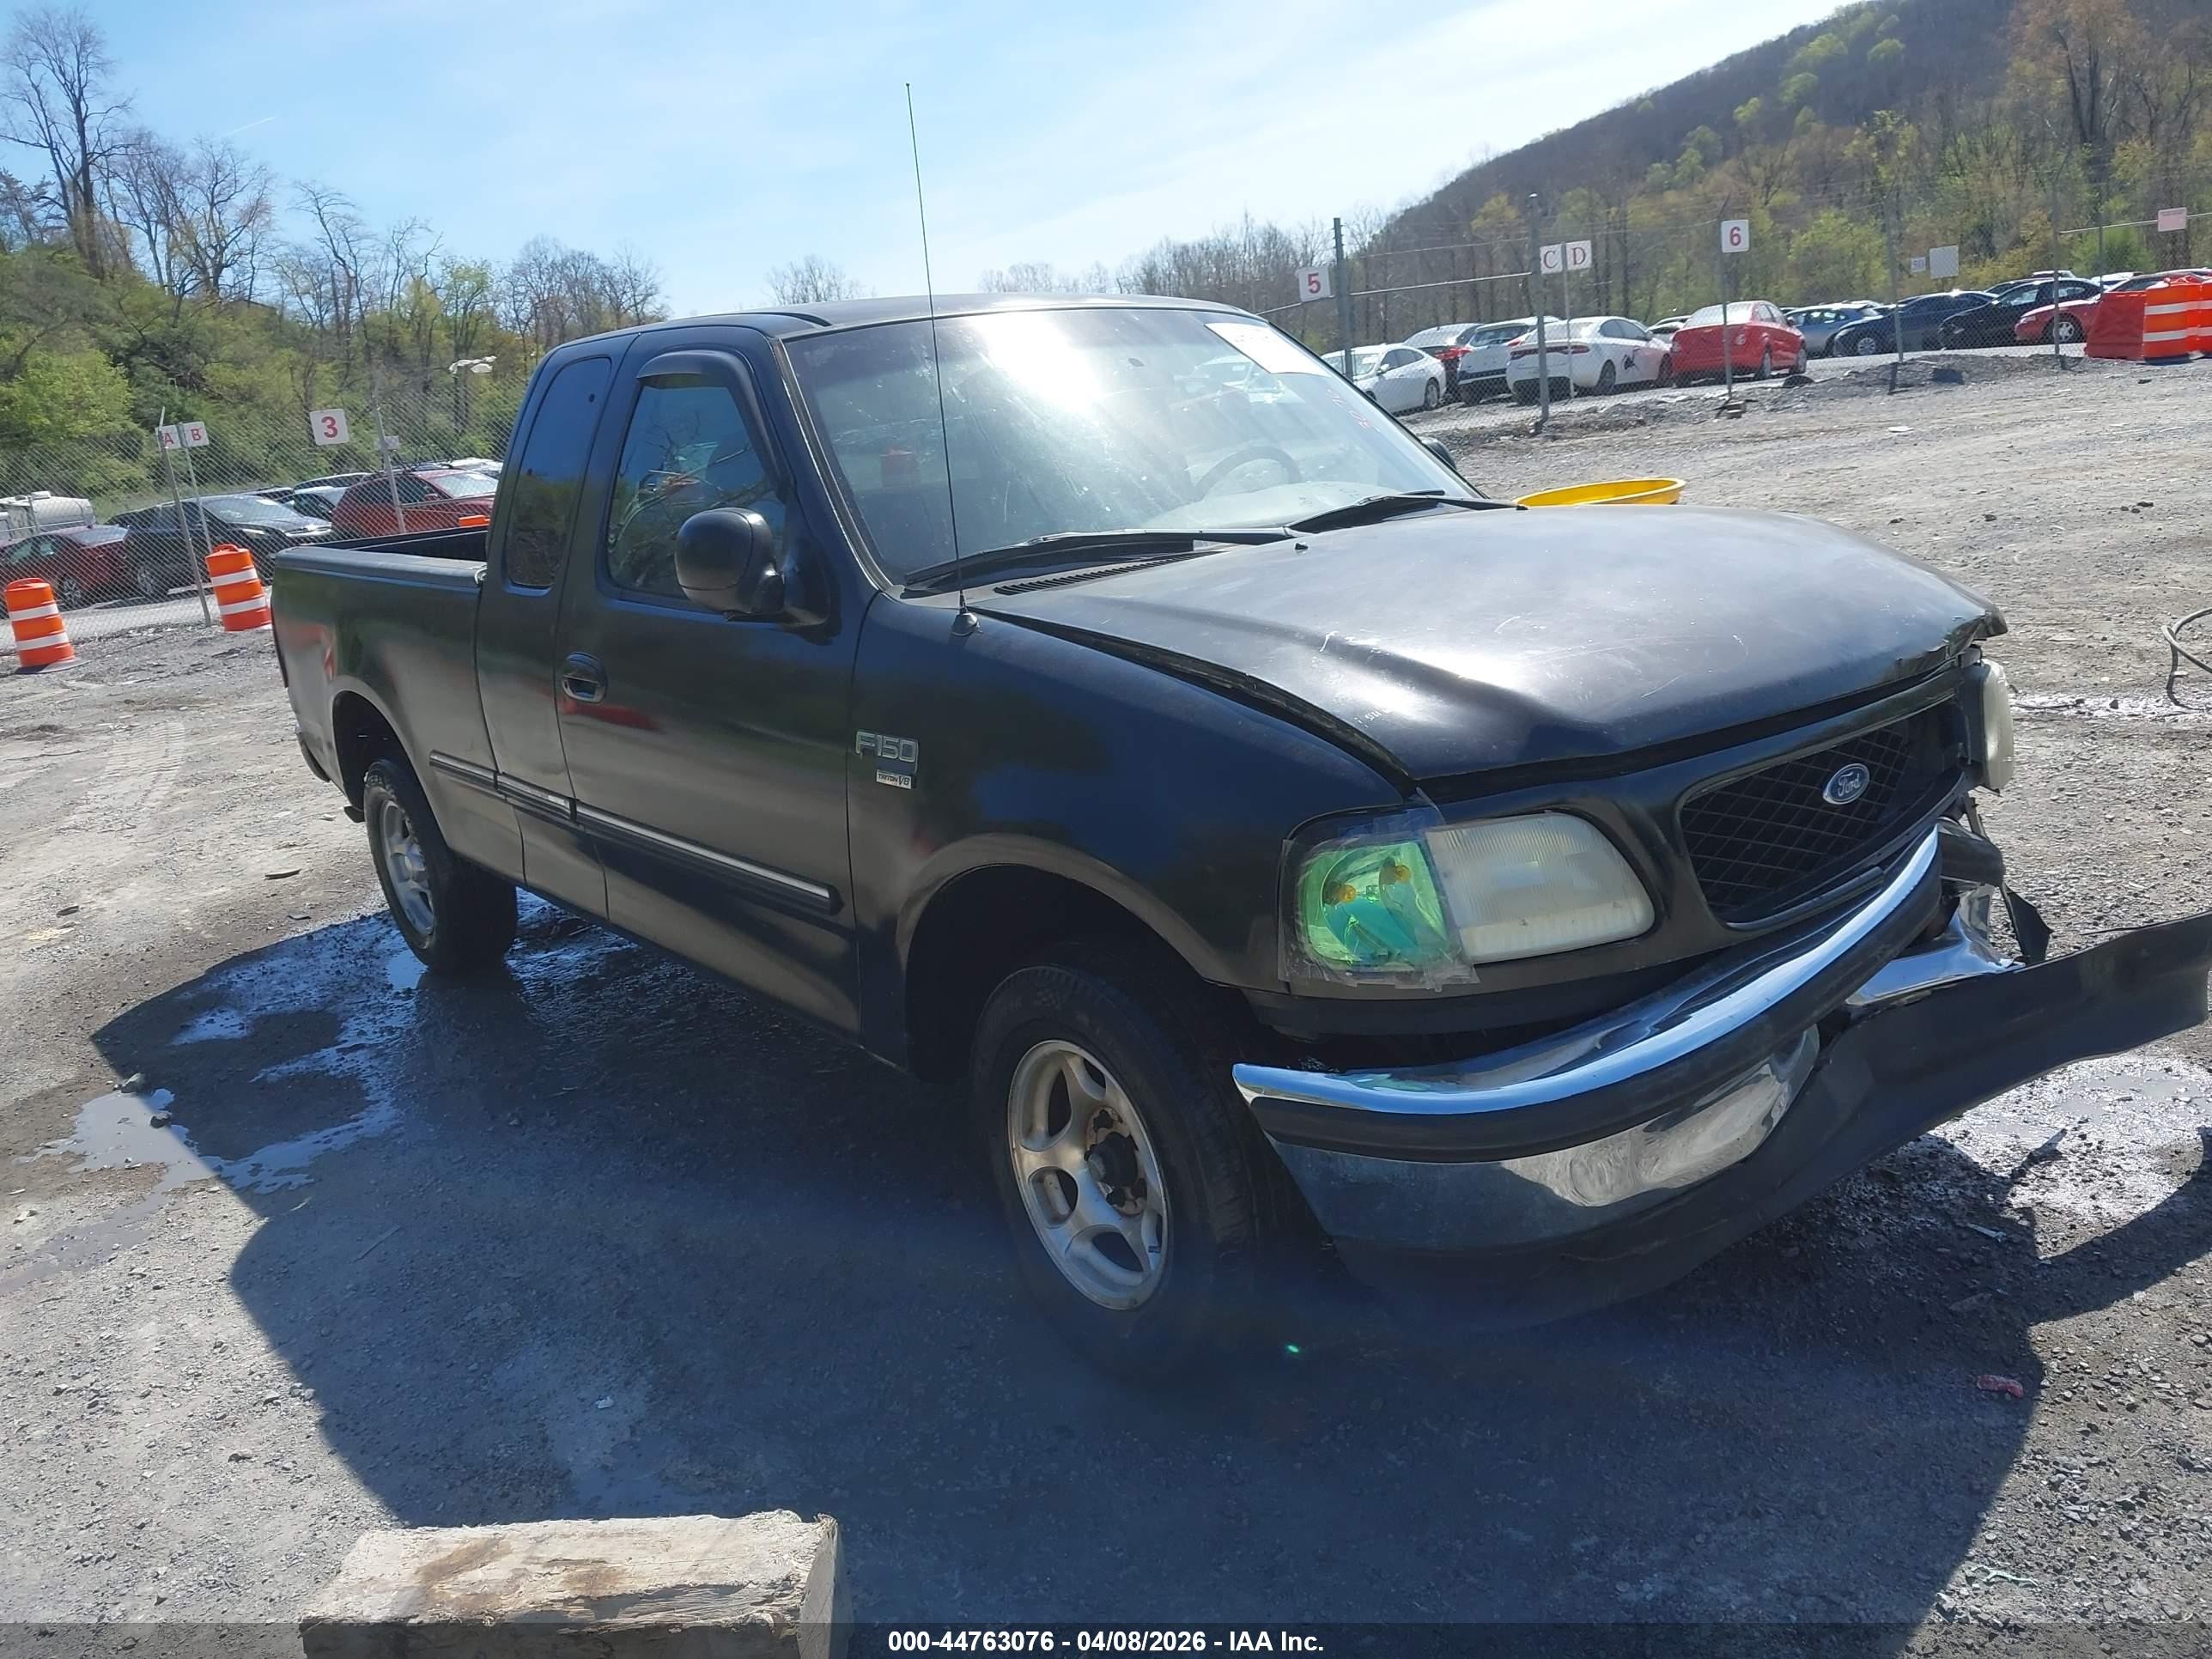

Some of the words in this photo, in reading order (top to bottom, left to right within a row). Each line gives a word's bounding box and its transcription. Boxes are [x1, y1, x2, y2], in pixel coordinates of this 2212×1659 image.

[1730, 226, 1741, 246] 6
[1543, 250, 1559, 269] C
[1571, 246, 1587, 265] D
[1307, 272, 1321, 294] 5
[191, 428, 201, 441] B
[321, 416, 338, 438] 3
[164, 432, 174, 445] A
[898, 775, 910, 786] V8
[1838, 771, 1861, 797] Ford
